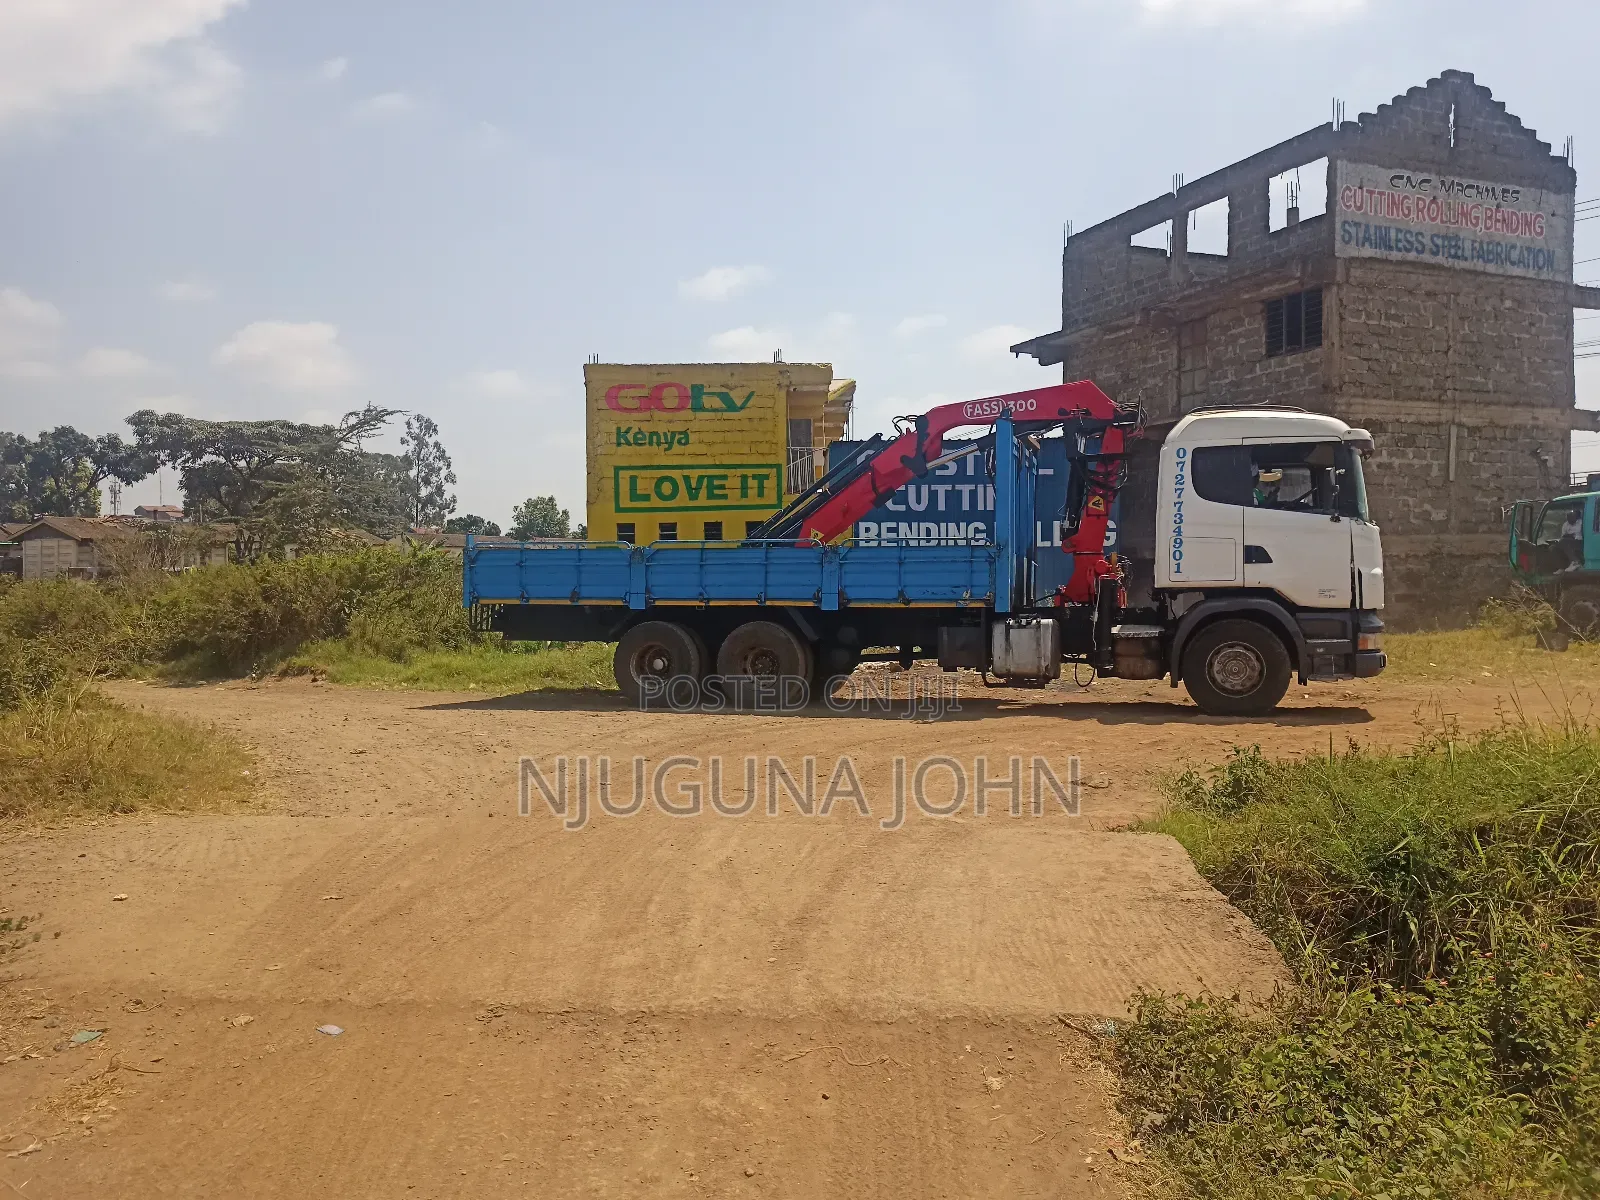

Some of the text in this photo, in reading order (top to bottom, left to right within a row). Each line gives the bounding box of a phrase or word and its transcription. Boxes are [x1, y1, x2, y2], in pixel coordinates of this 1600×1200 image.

[1389, 174, 1521, 203] CNC MACHINES
[1340, 220, 1556, 272] STAINLESS STEEL FABRICATION
[966, 398, 1037, 417] FASSI 300
[615, 426, 690, 452] Kenya
[629, 473, 770, 503] LOVE IT
[885, 484, 997, 512] CUTTI
[1172, 447, 1188, 574] 0727734901
